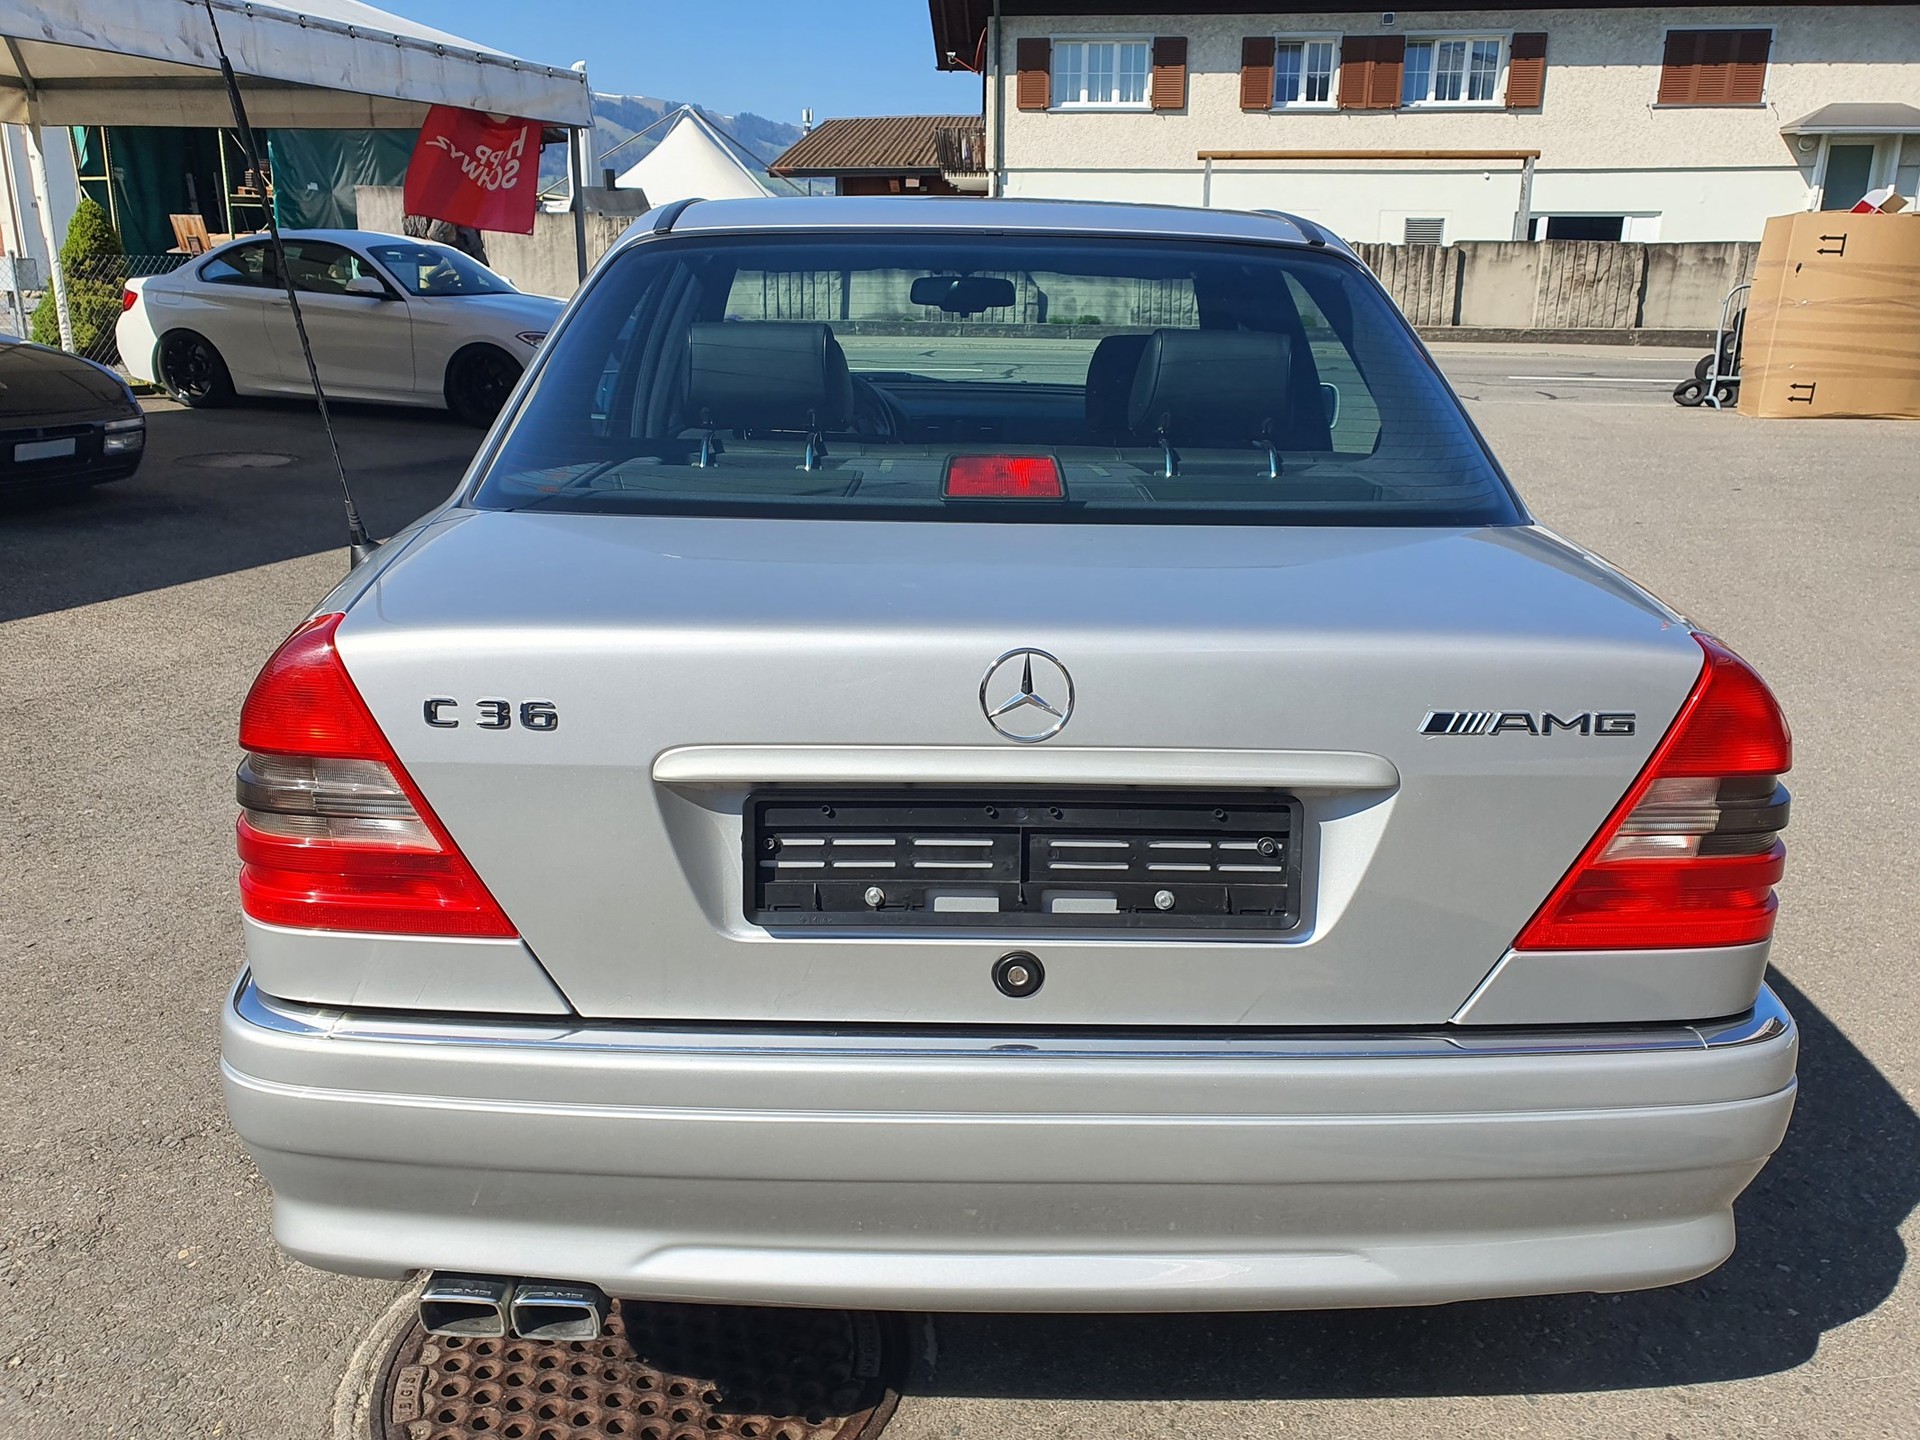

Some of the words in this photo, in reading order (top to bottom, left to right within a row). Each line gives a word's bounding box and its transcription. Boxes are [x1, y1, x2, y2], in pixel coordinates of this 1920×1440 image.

[423, 698, 459, 729] C
[475, 699, 559, 732] 36
[1486, 710, 1637, 736] AMG
